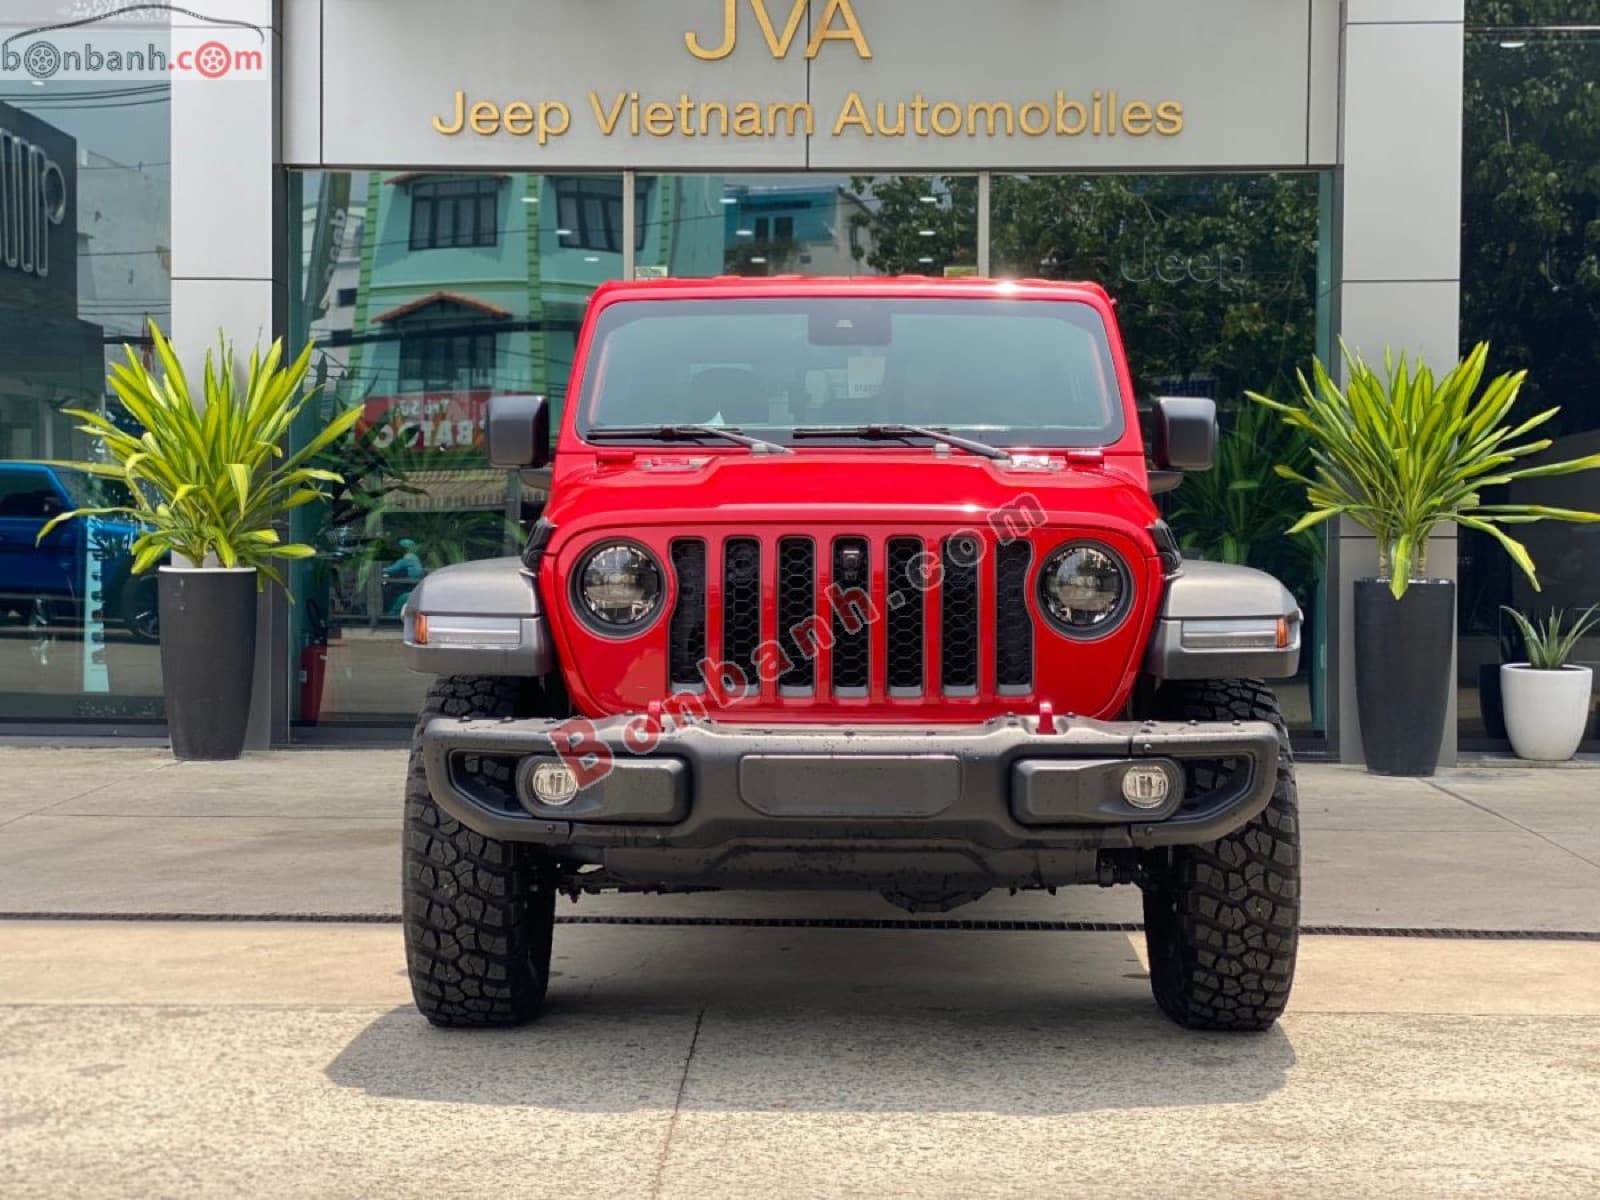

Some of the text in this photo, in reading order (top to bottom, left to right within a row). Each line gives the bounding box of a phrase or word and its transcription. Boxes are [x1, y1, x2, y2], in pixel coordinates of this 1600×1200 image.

[685, 0, 872, 62] JVA
[432, 91, 1184, 145] Jeep Vietnam Automobiles
